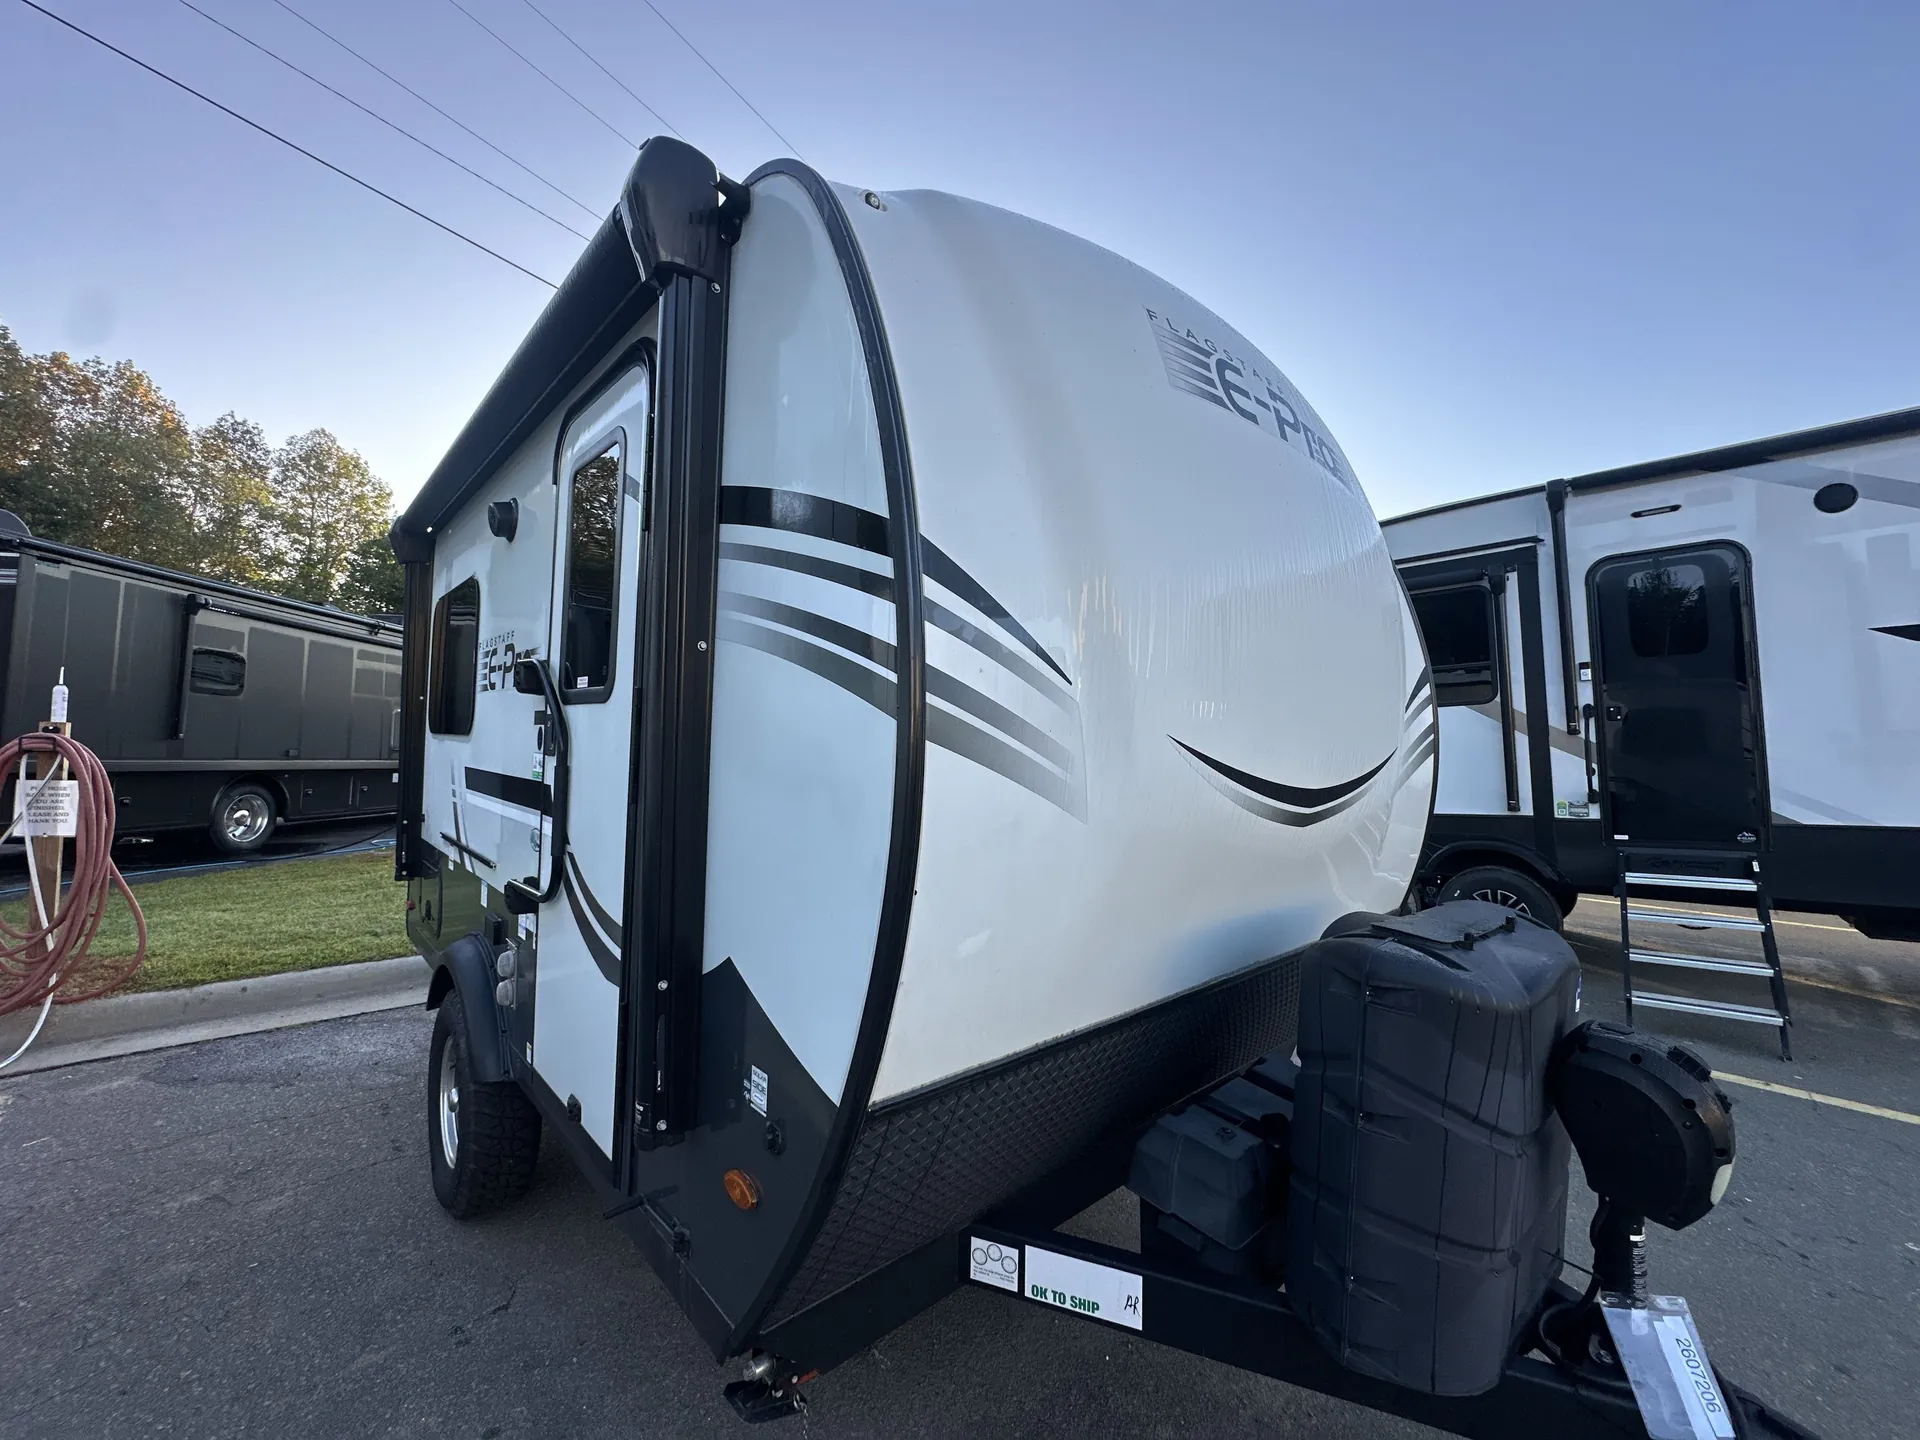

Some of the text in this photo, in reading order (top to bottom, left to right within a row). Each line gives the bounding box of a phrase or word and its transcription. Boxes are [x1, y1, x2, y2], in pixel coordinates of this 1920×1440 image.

[1145, 307, 1284, 395] FLAGSTAFF
[479, 630, 515, 651] FLAGSTAFF
[1031, 1284, 1100, 1314] OK TO SHIP
[1675, 1337, 1722, 1413] 2607206
